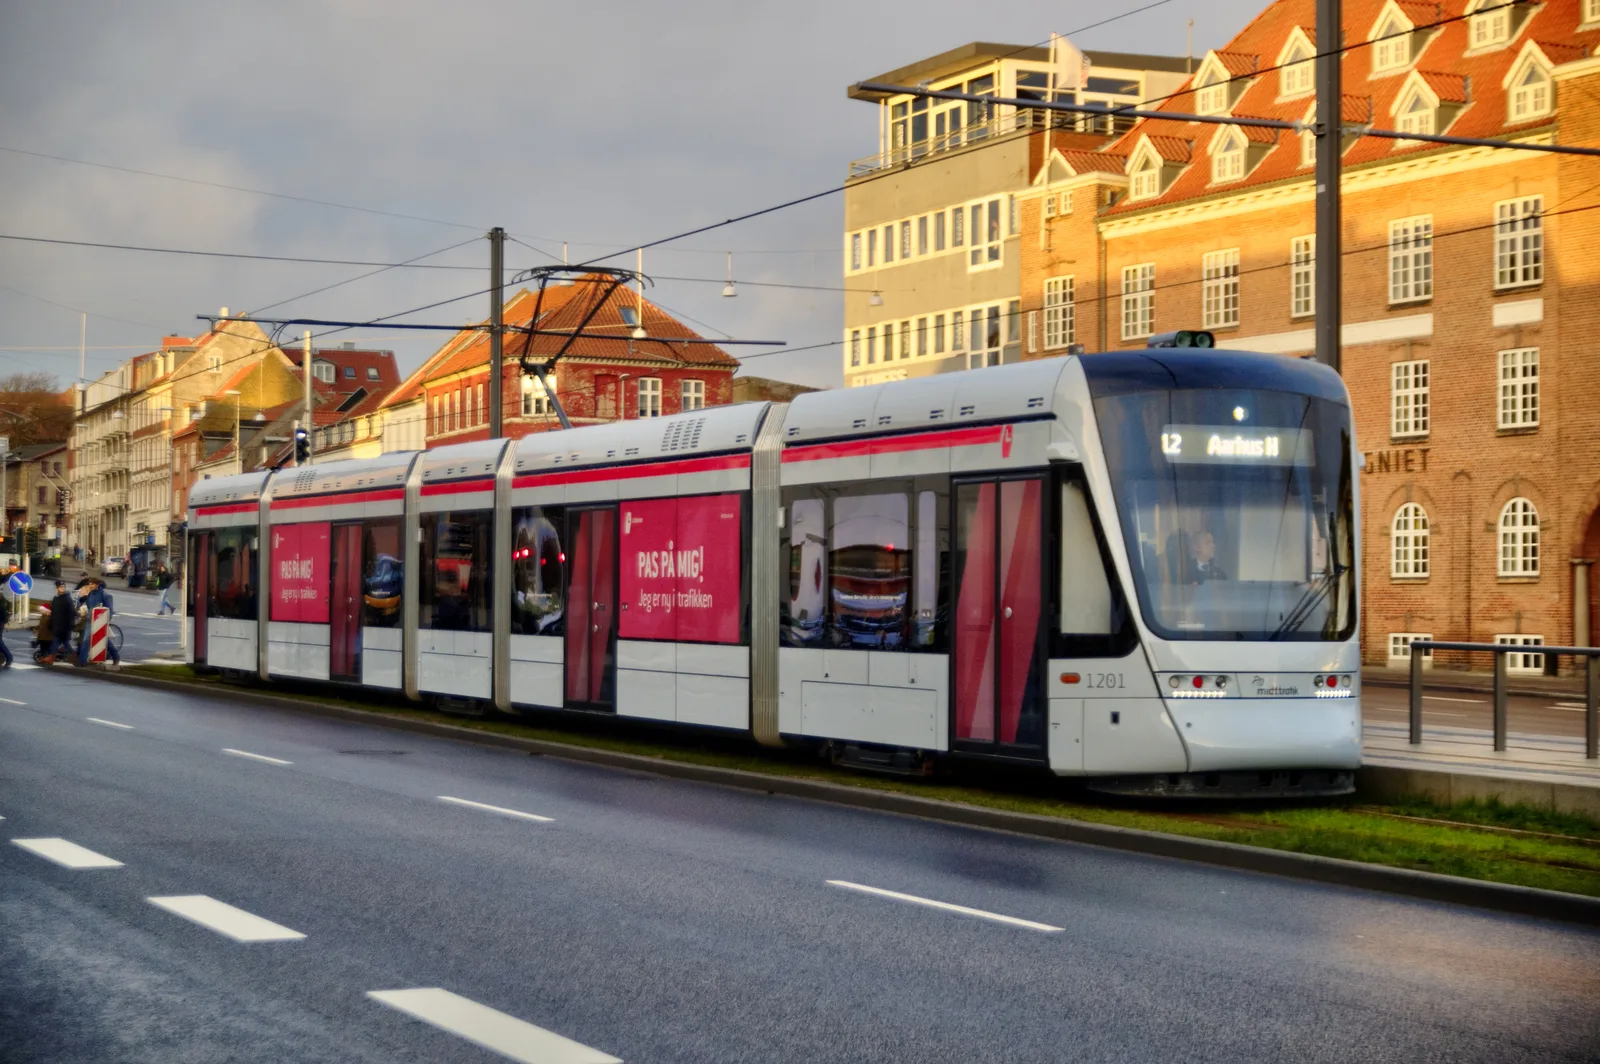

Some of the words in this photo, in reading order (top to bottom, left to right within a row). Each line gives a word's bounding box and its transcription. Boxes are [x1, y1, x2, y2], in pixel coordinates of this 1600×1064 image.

[1161, 433, 1182, 454] L2
[1207, 434, 1265, 456] Aarhus
[1264, 436, 1279, 456] H
[637, 551, 659, 578] PAS
[661, 540, 676, 578] PÅ
[677, 545, 704, 583] MIG!
[638, 588, 652, 613] Jeg
[652, 593, 661, 607] er
[661, 593, 671, 613] ny
[677, 588, 713, 608] trafikken
[1086, 673, 1126, 689] 1201
